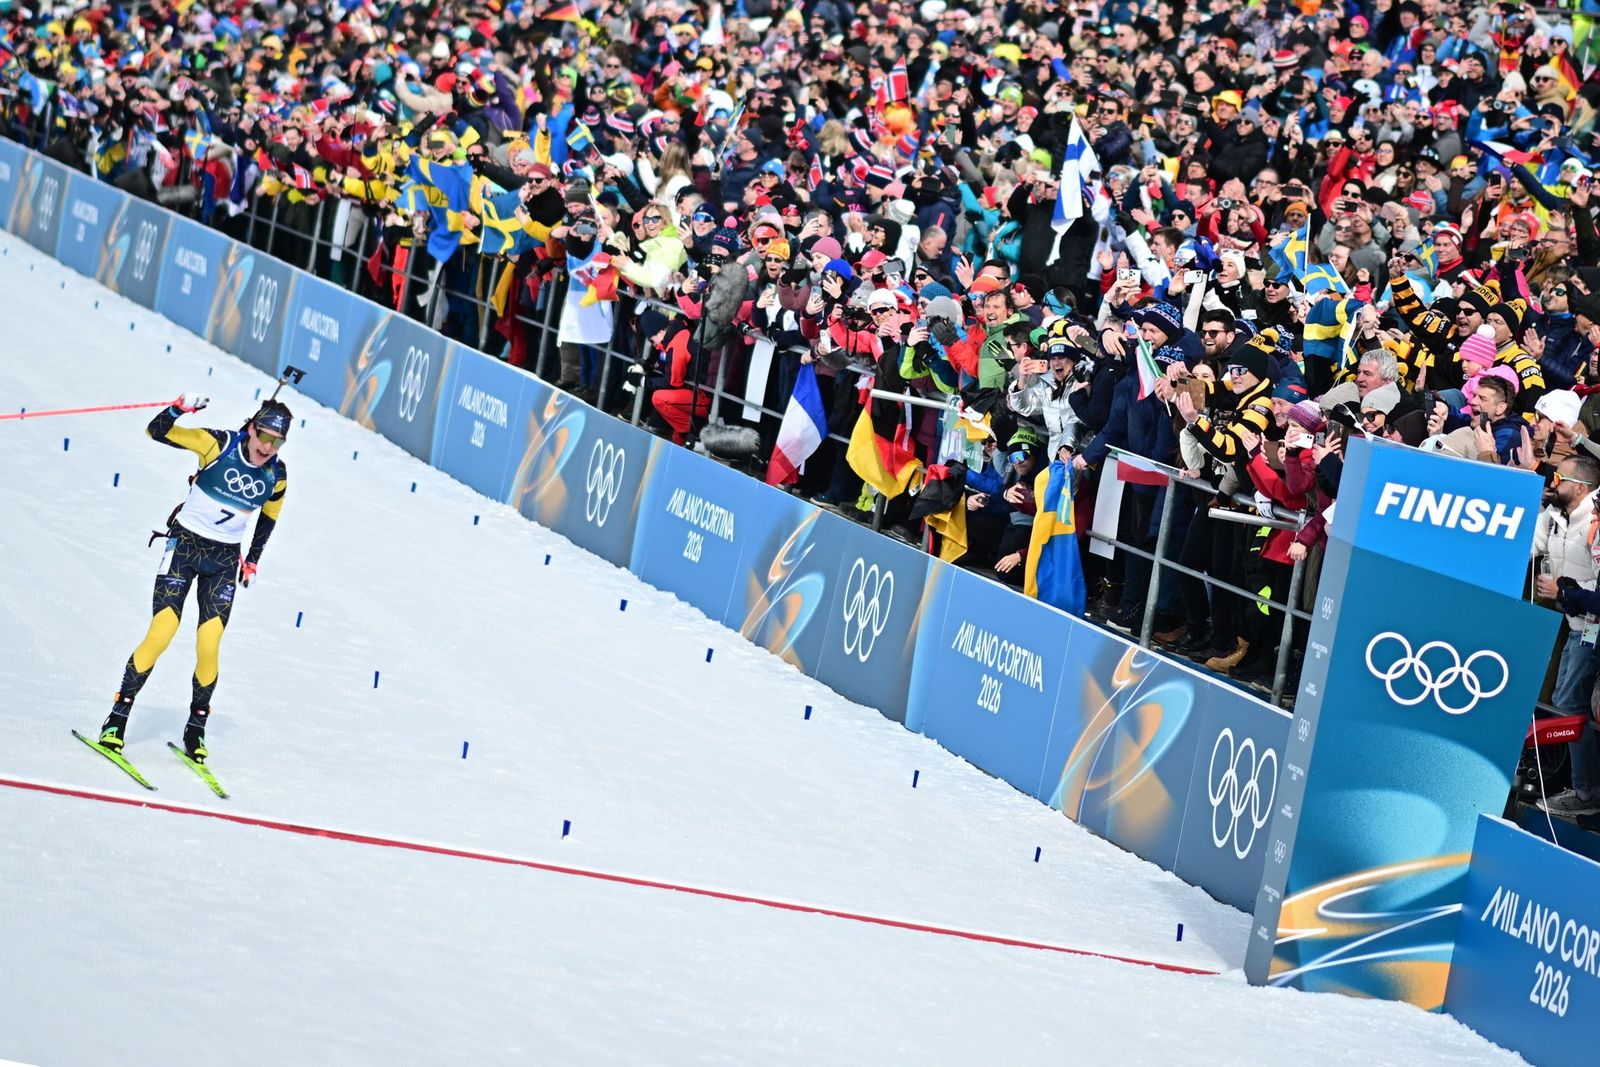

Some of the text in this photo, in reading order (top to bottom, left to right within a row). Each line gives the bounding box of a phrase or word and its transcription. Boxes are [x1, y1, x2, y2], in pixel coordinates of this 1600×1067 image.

[458, 384, 508, 429] MILANO CORTINA
[471, 420, 486, 449] 2026
[214, 508, 235, 525] 7
[666, 487, 734, 543] MILANO CORTINA
[1374, 481, 1525, 540] FINISH
[683, 529, 704, 563] 2026
[951, 620, 1043, 693] MILANO CORTINA
[976, 673, 1003, 714] 2026
[1552, 729, 1575, 738] OMEGA
[1480, 885, 1600, 979] MILANO COR
[1529, 960, 1571, 1018] 2026
